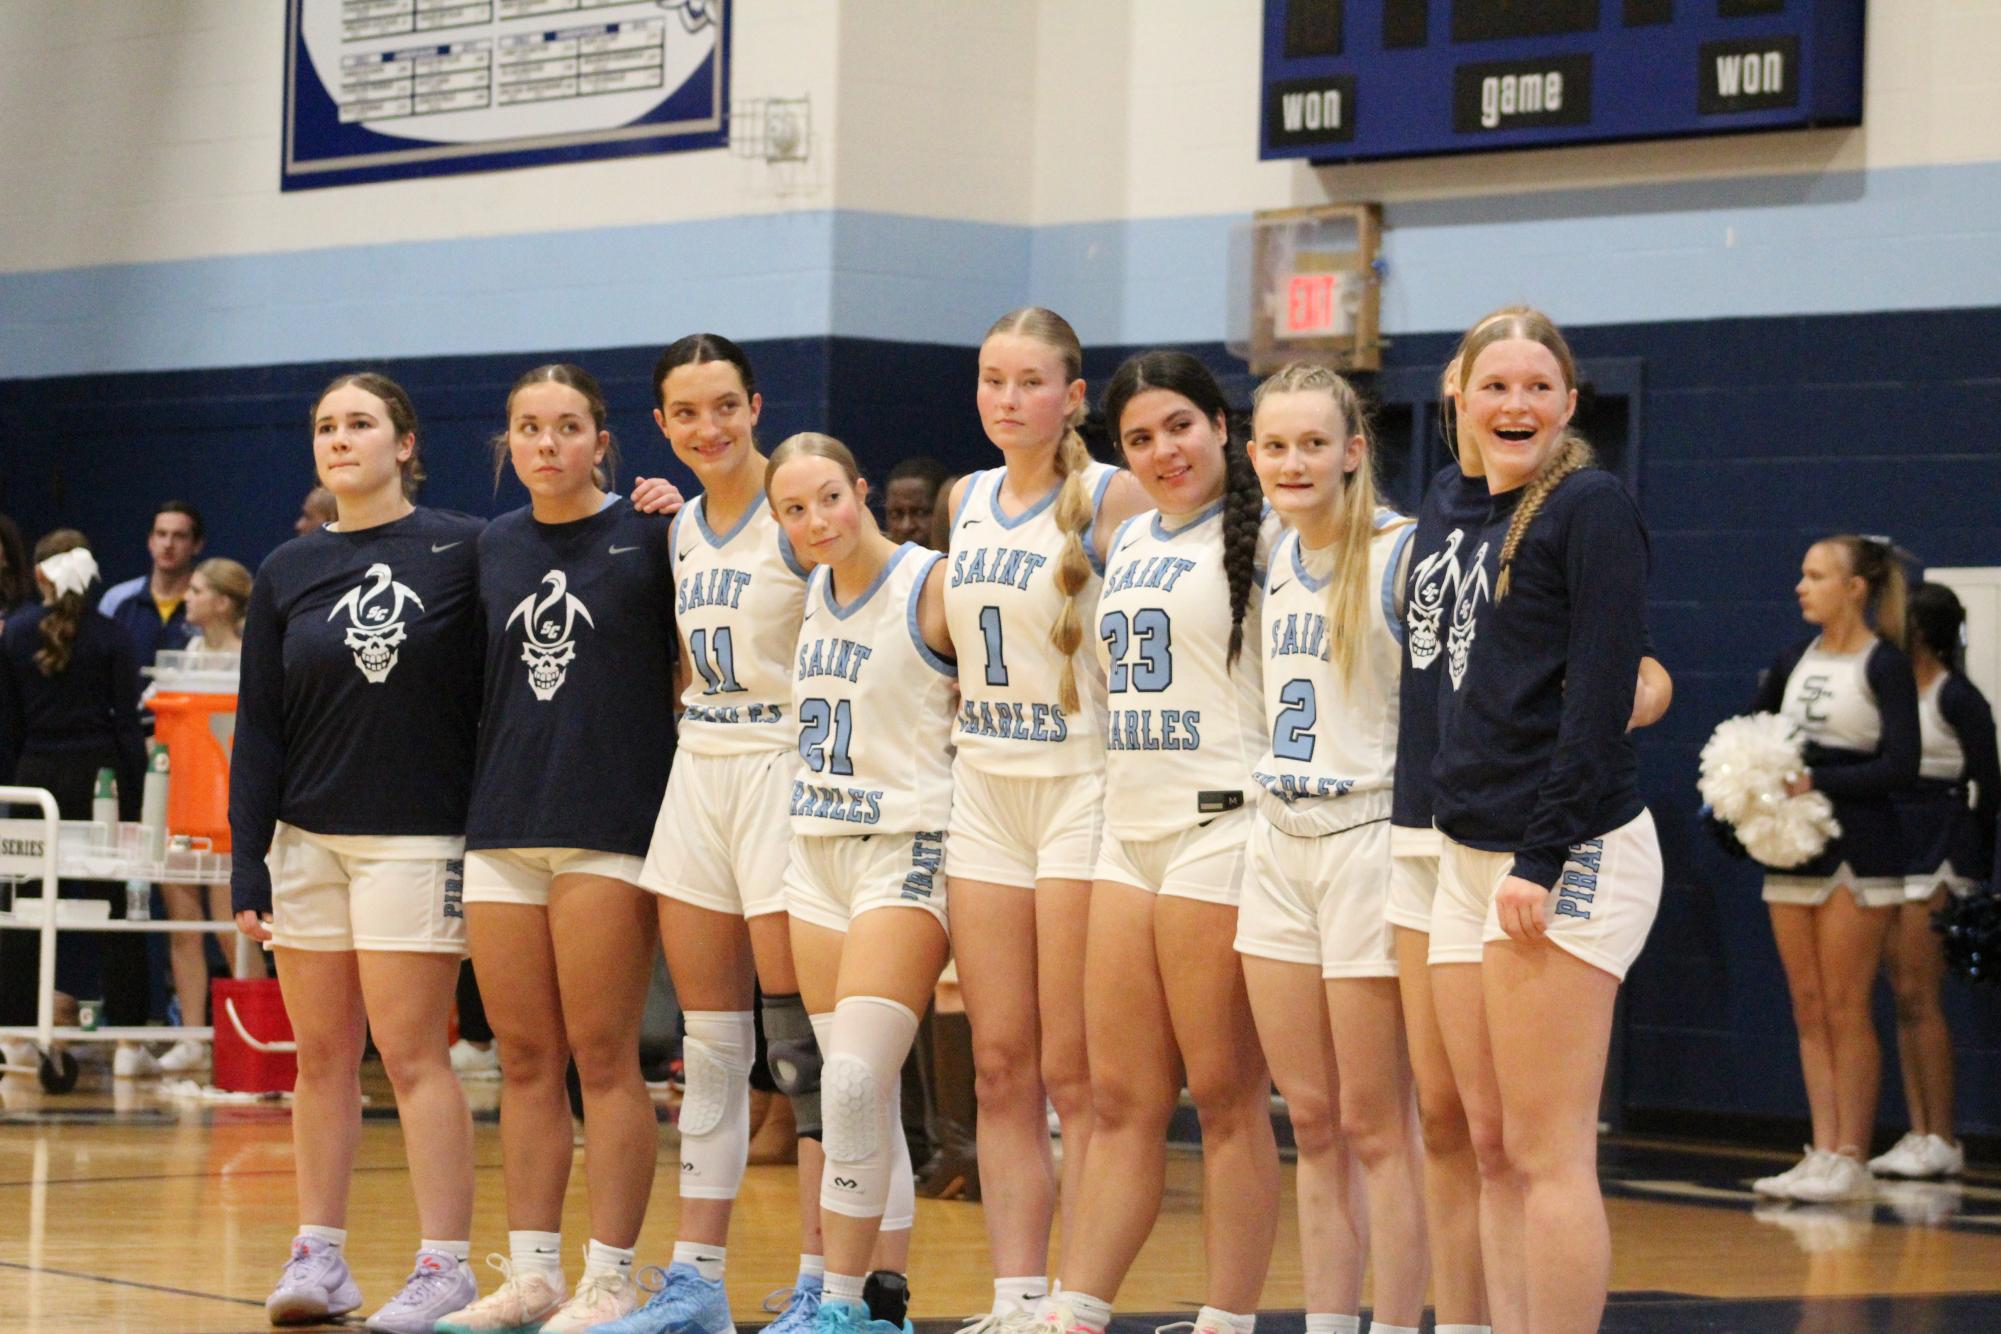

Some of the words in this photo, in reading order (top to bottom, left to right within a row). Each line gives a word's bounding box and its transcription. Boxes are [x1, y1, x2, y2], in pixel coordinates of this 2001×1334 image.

[1716, 50, 1784, 97] won
[1282, 89, 1343, 132] won
[1480, 71, 1564, 129] game
[1288, 274, 1336, 332] EXIT
[678, 568, 752, 616] SAINT
[951, 547, 1048, 591] SAINT
[1102, 555, 1197, 600] SAINT
[540, 620, 561, 639] SC
[979, 605, 1009, 687] 1
[1099, 607, 1173, 694] 23
[690, 626, 749, 695] 11
[798, 638, 873, 684] SAINT
[798, 697, 854, 777] 21
[1107, 709, 1201, 752] ARLES
[1272, 678, 1317, 763] 2
[1, 838, 45, 858] SERIES
